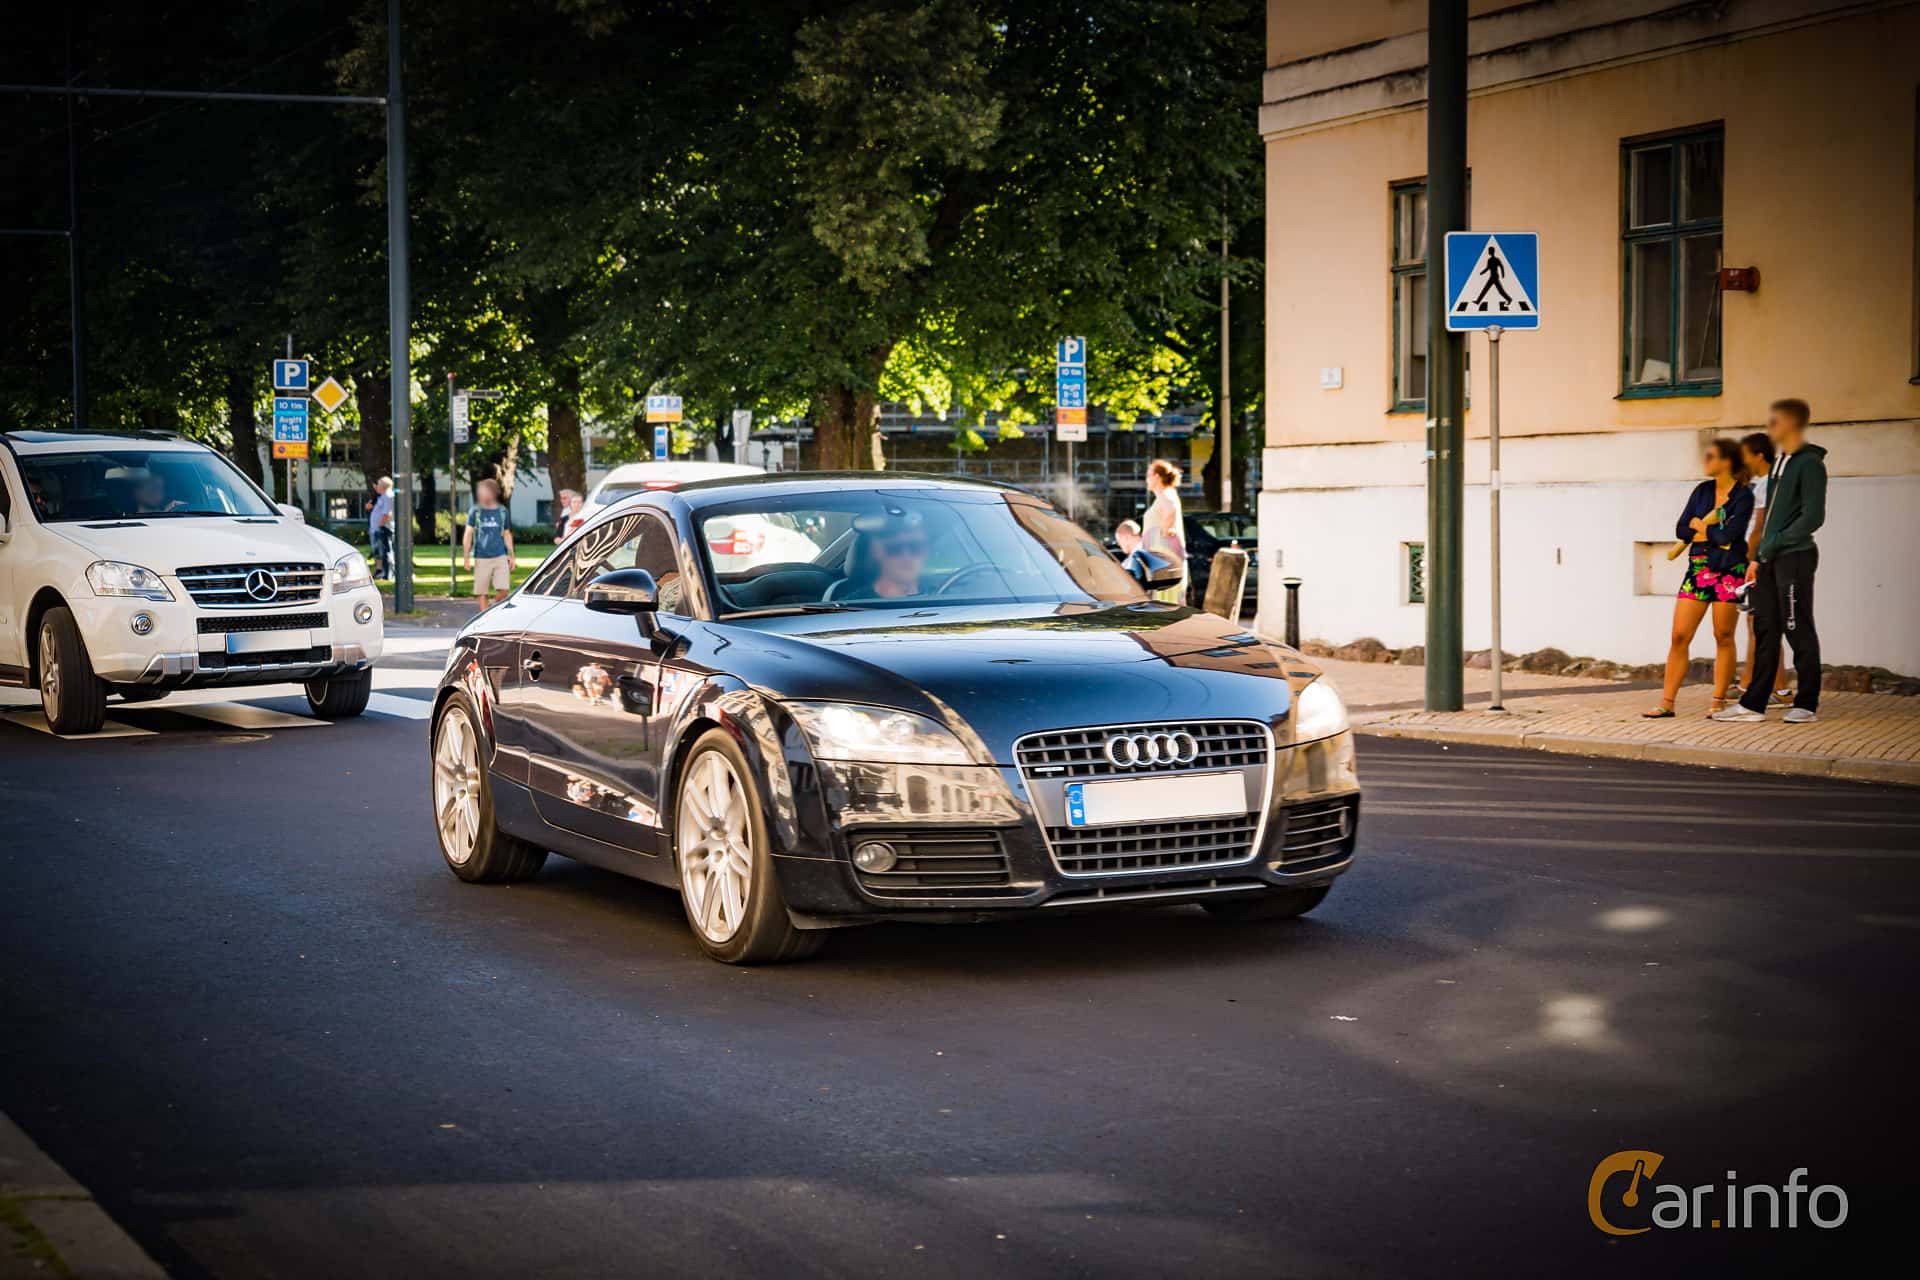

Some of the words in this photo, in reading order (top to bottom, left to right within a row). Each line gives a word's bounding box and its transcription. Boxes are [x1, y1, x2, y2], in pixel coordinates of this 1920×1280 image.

[1065, 339, 1080, 361] P
[284, 363, 301, 386] P
[279, 401, 289, 409] 10
[290, 401, 304, 409] tim
[279, 416, 302, 425] Avgift
[1072, 808, 1083, 819] S
